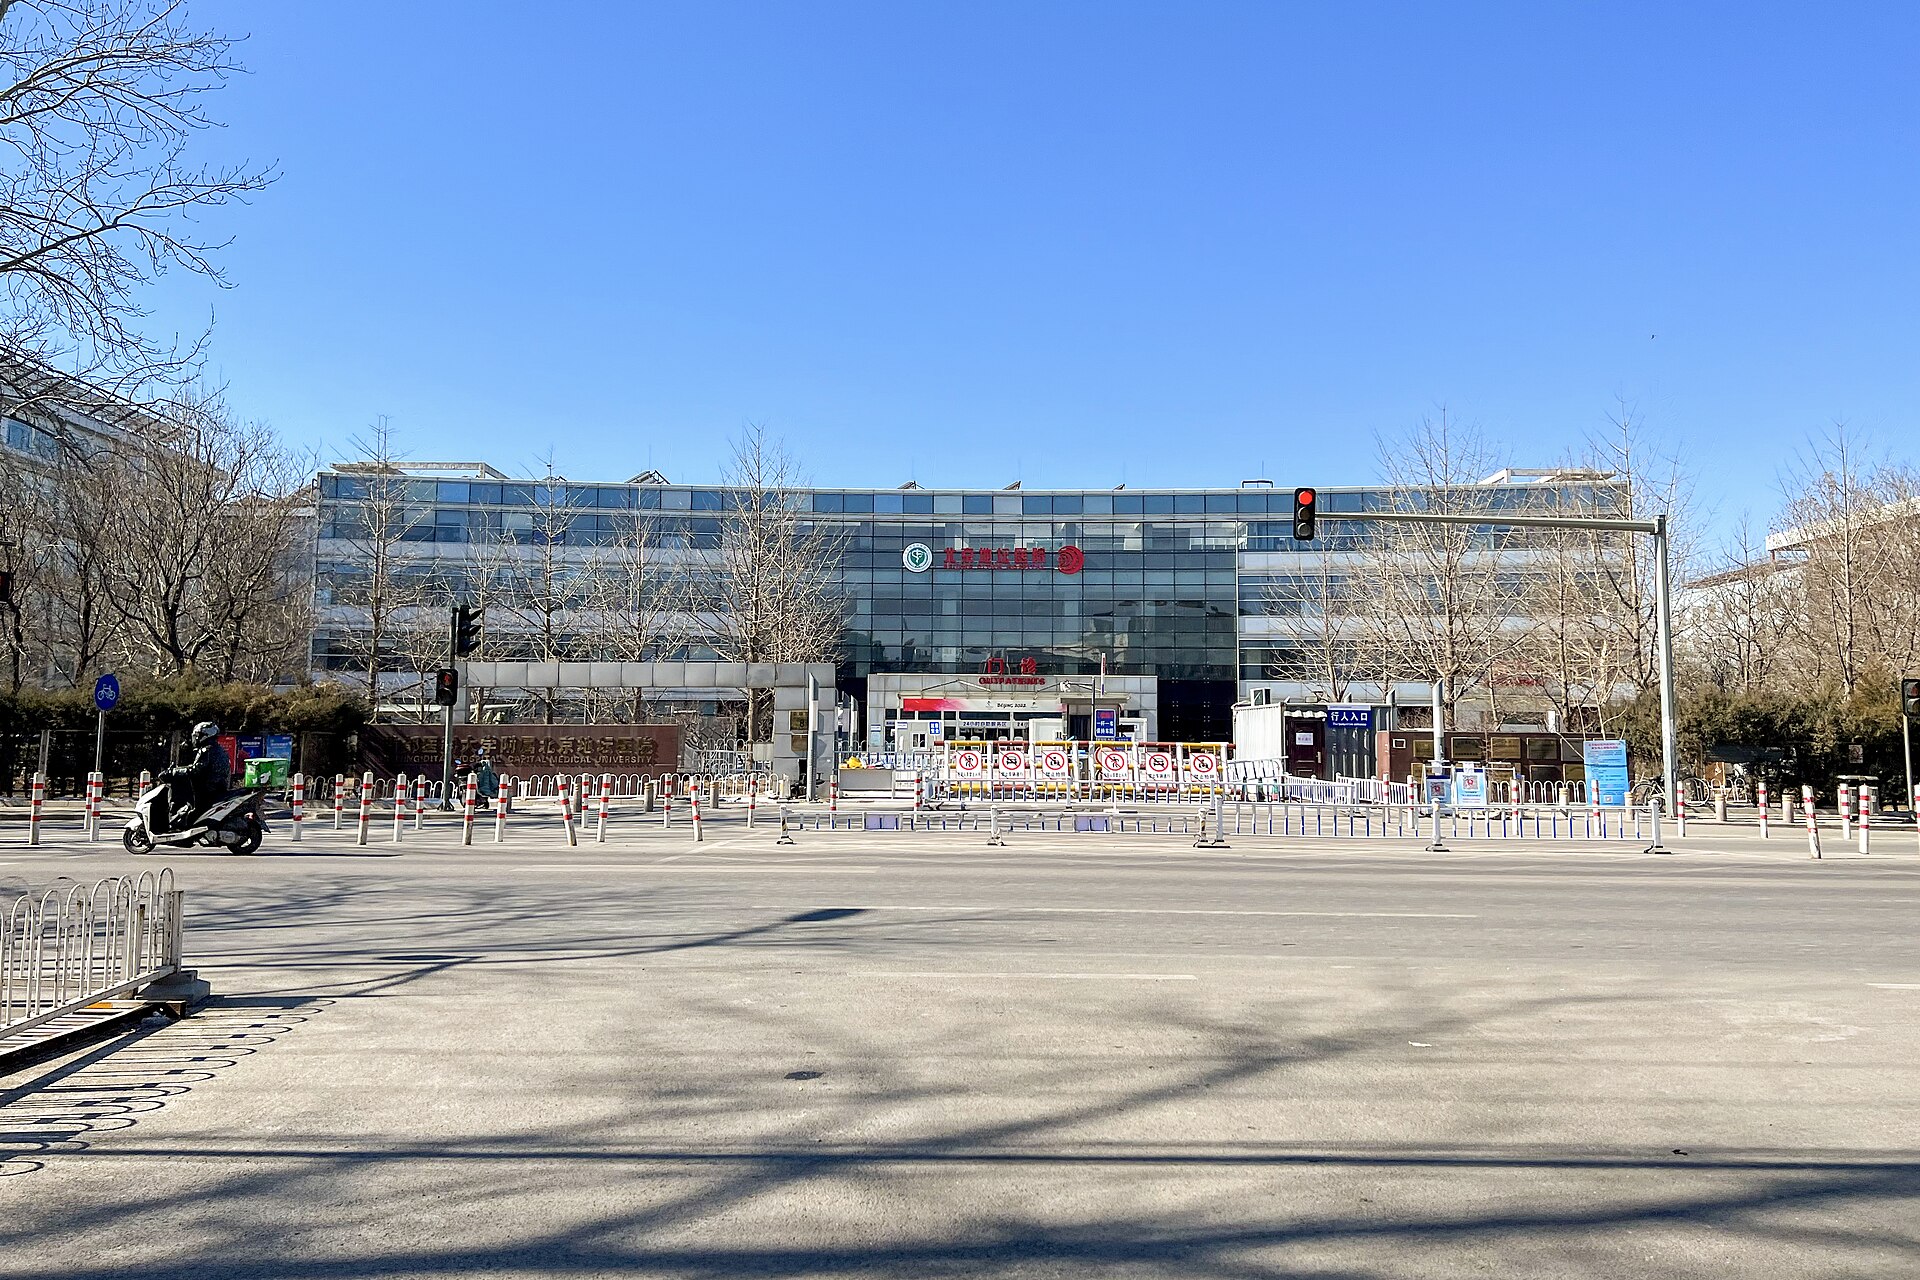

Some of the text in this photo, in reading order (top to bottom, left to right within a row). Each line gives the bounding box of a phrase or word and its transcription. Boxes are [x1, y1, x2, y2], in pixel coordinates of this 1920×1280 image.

[944, 548, 1046, 563] 北京地坛医院
[987, 657, 1037, 674] 门诊
[978, 677, 1045, 685] OUTPATIENTS
[1331, 712, 1368, 721] 行人入口
[507, 755, 547, 764] CAPITAL
[549, 755, 591, 764] MEDICAL
[595, 755, 652, 764] UNIVERSITY
